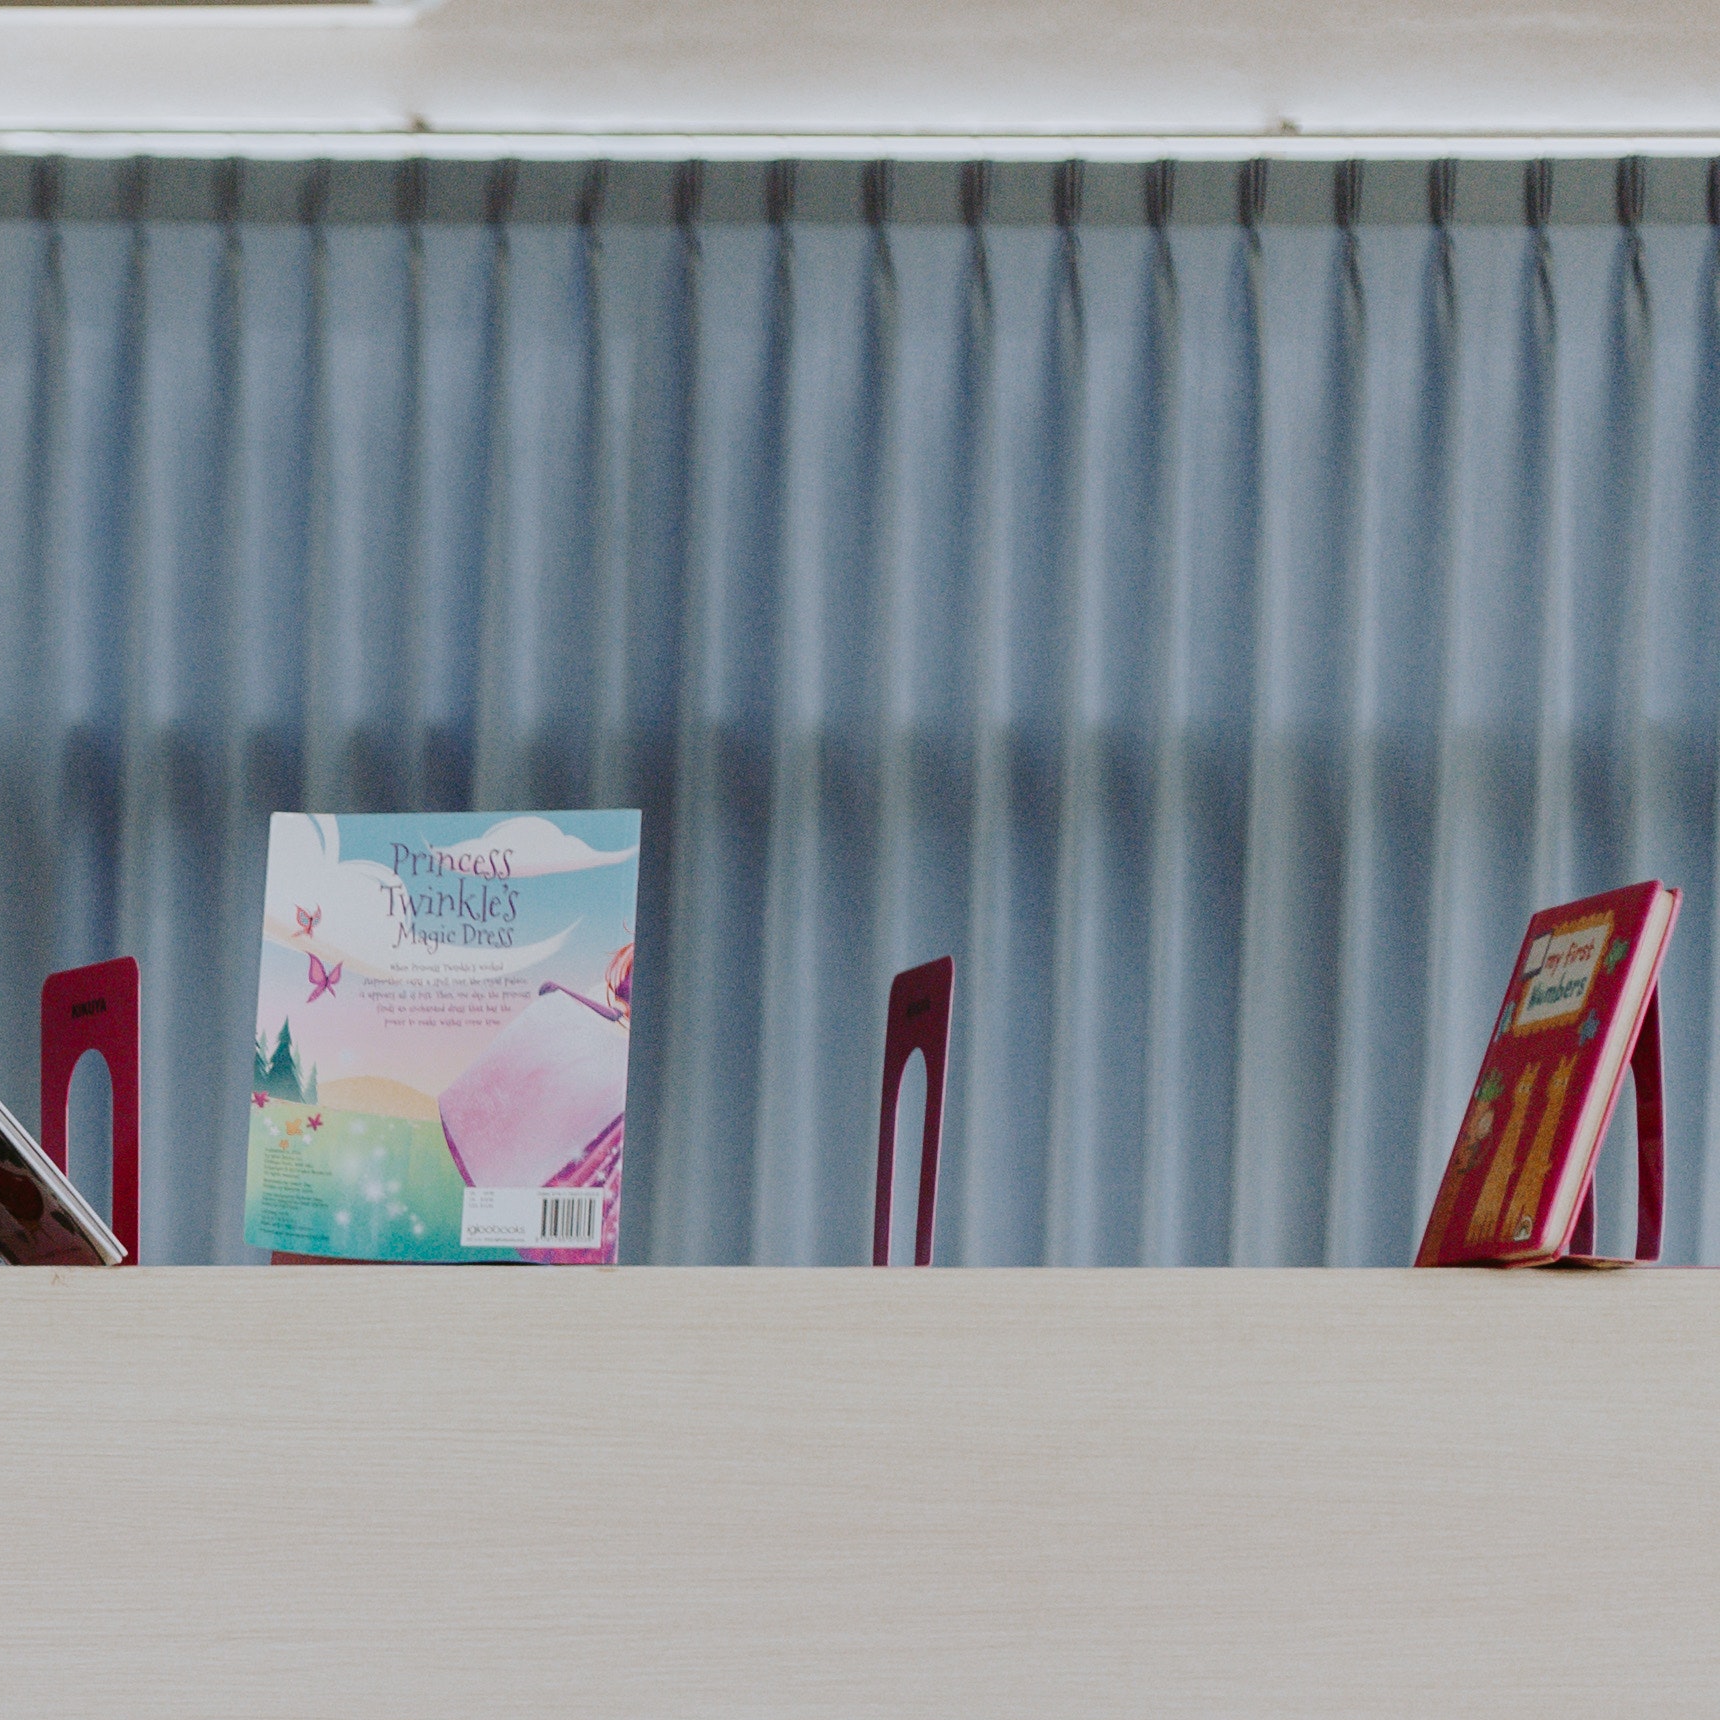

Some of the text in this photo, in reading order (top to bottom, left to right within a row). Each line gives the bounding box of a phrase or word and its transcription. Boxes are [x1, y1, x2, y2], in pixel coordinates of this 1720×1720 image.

[390, 842, 515, 880] Princess
[380, 882, 520, 922] Twinkle's
[393, 922, 515, 953] Magic Dress
[71, 998, 108, 1019] KIKUYA
